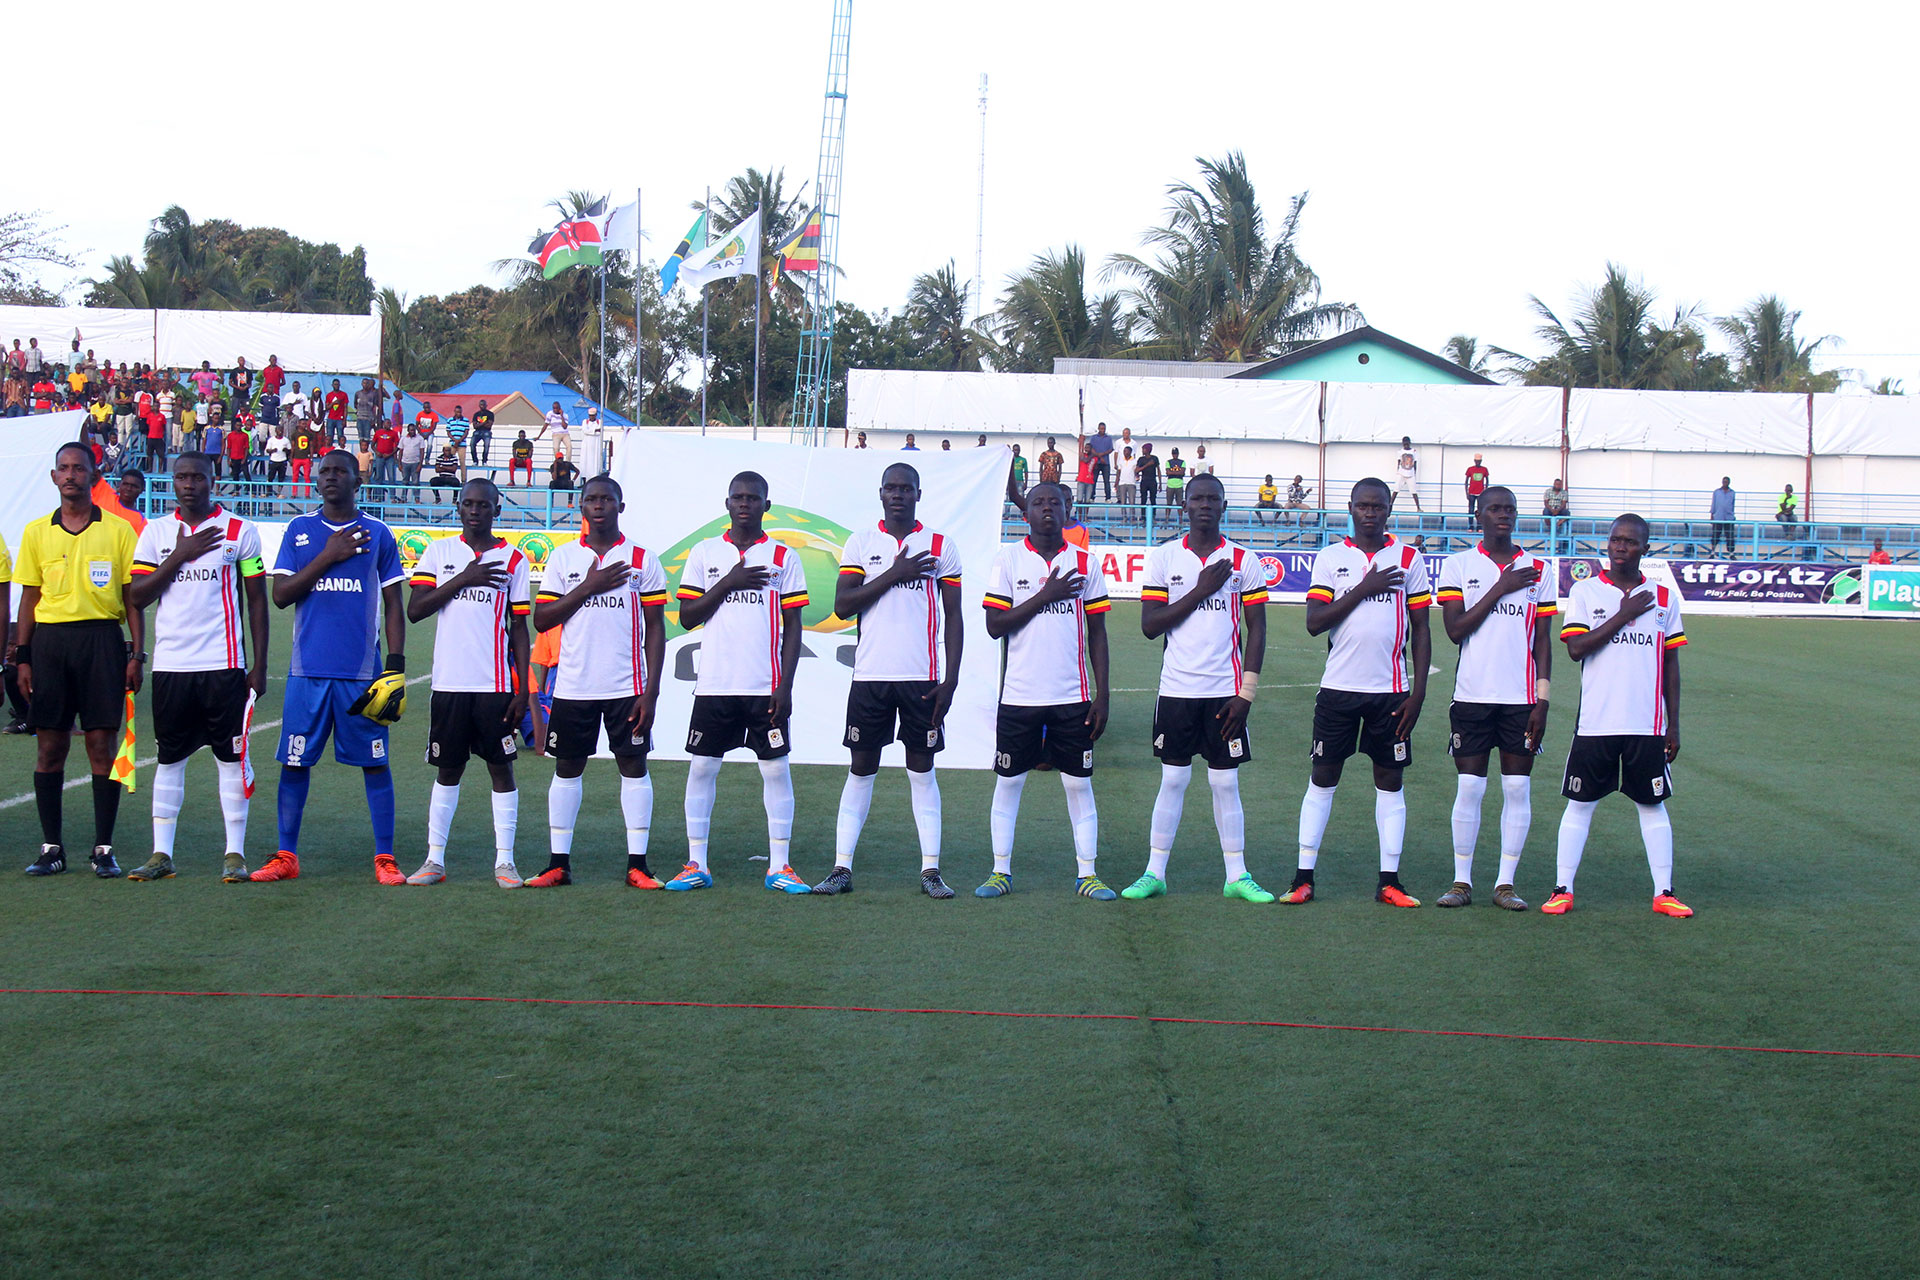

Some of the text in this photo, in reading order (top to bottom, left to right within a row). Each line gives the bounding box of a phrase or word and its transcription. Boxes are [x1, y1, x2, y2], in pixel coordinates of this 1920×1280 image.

[297, 435, 308, 449] G
[175, 568, 218, 583] GANDA
[1101, 553, 1144, 583] AF
[1681, 564, 1826, 585] tff.or.tz
[313, 577, 363, 592] GANDA
[892, 578, 924, 591] ANDA
[454, 589, 492, 604] GANDA
[725, 591, 765, 605] GANDA
[1704, 589, 1805, 599] Play Fair, Be Positive
[584, 596, 625, 609] GANDA
[1192, 599, 1227, 612] ANDA
[1491, 603, 1525, 617] ANDA
[1612, 631, 1653, 647] GANDA
[548, 731, 558, 748] 2
[688, 729, 703, 746] 17
[848, 725, 860, 742] 16
[1452, 733, 1462, 749] 6
[287, 734, 306, 756] 19
[1568, 775, 1582, 793] 10
